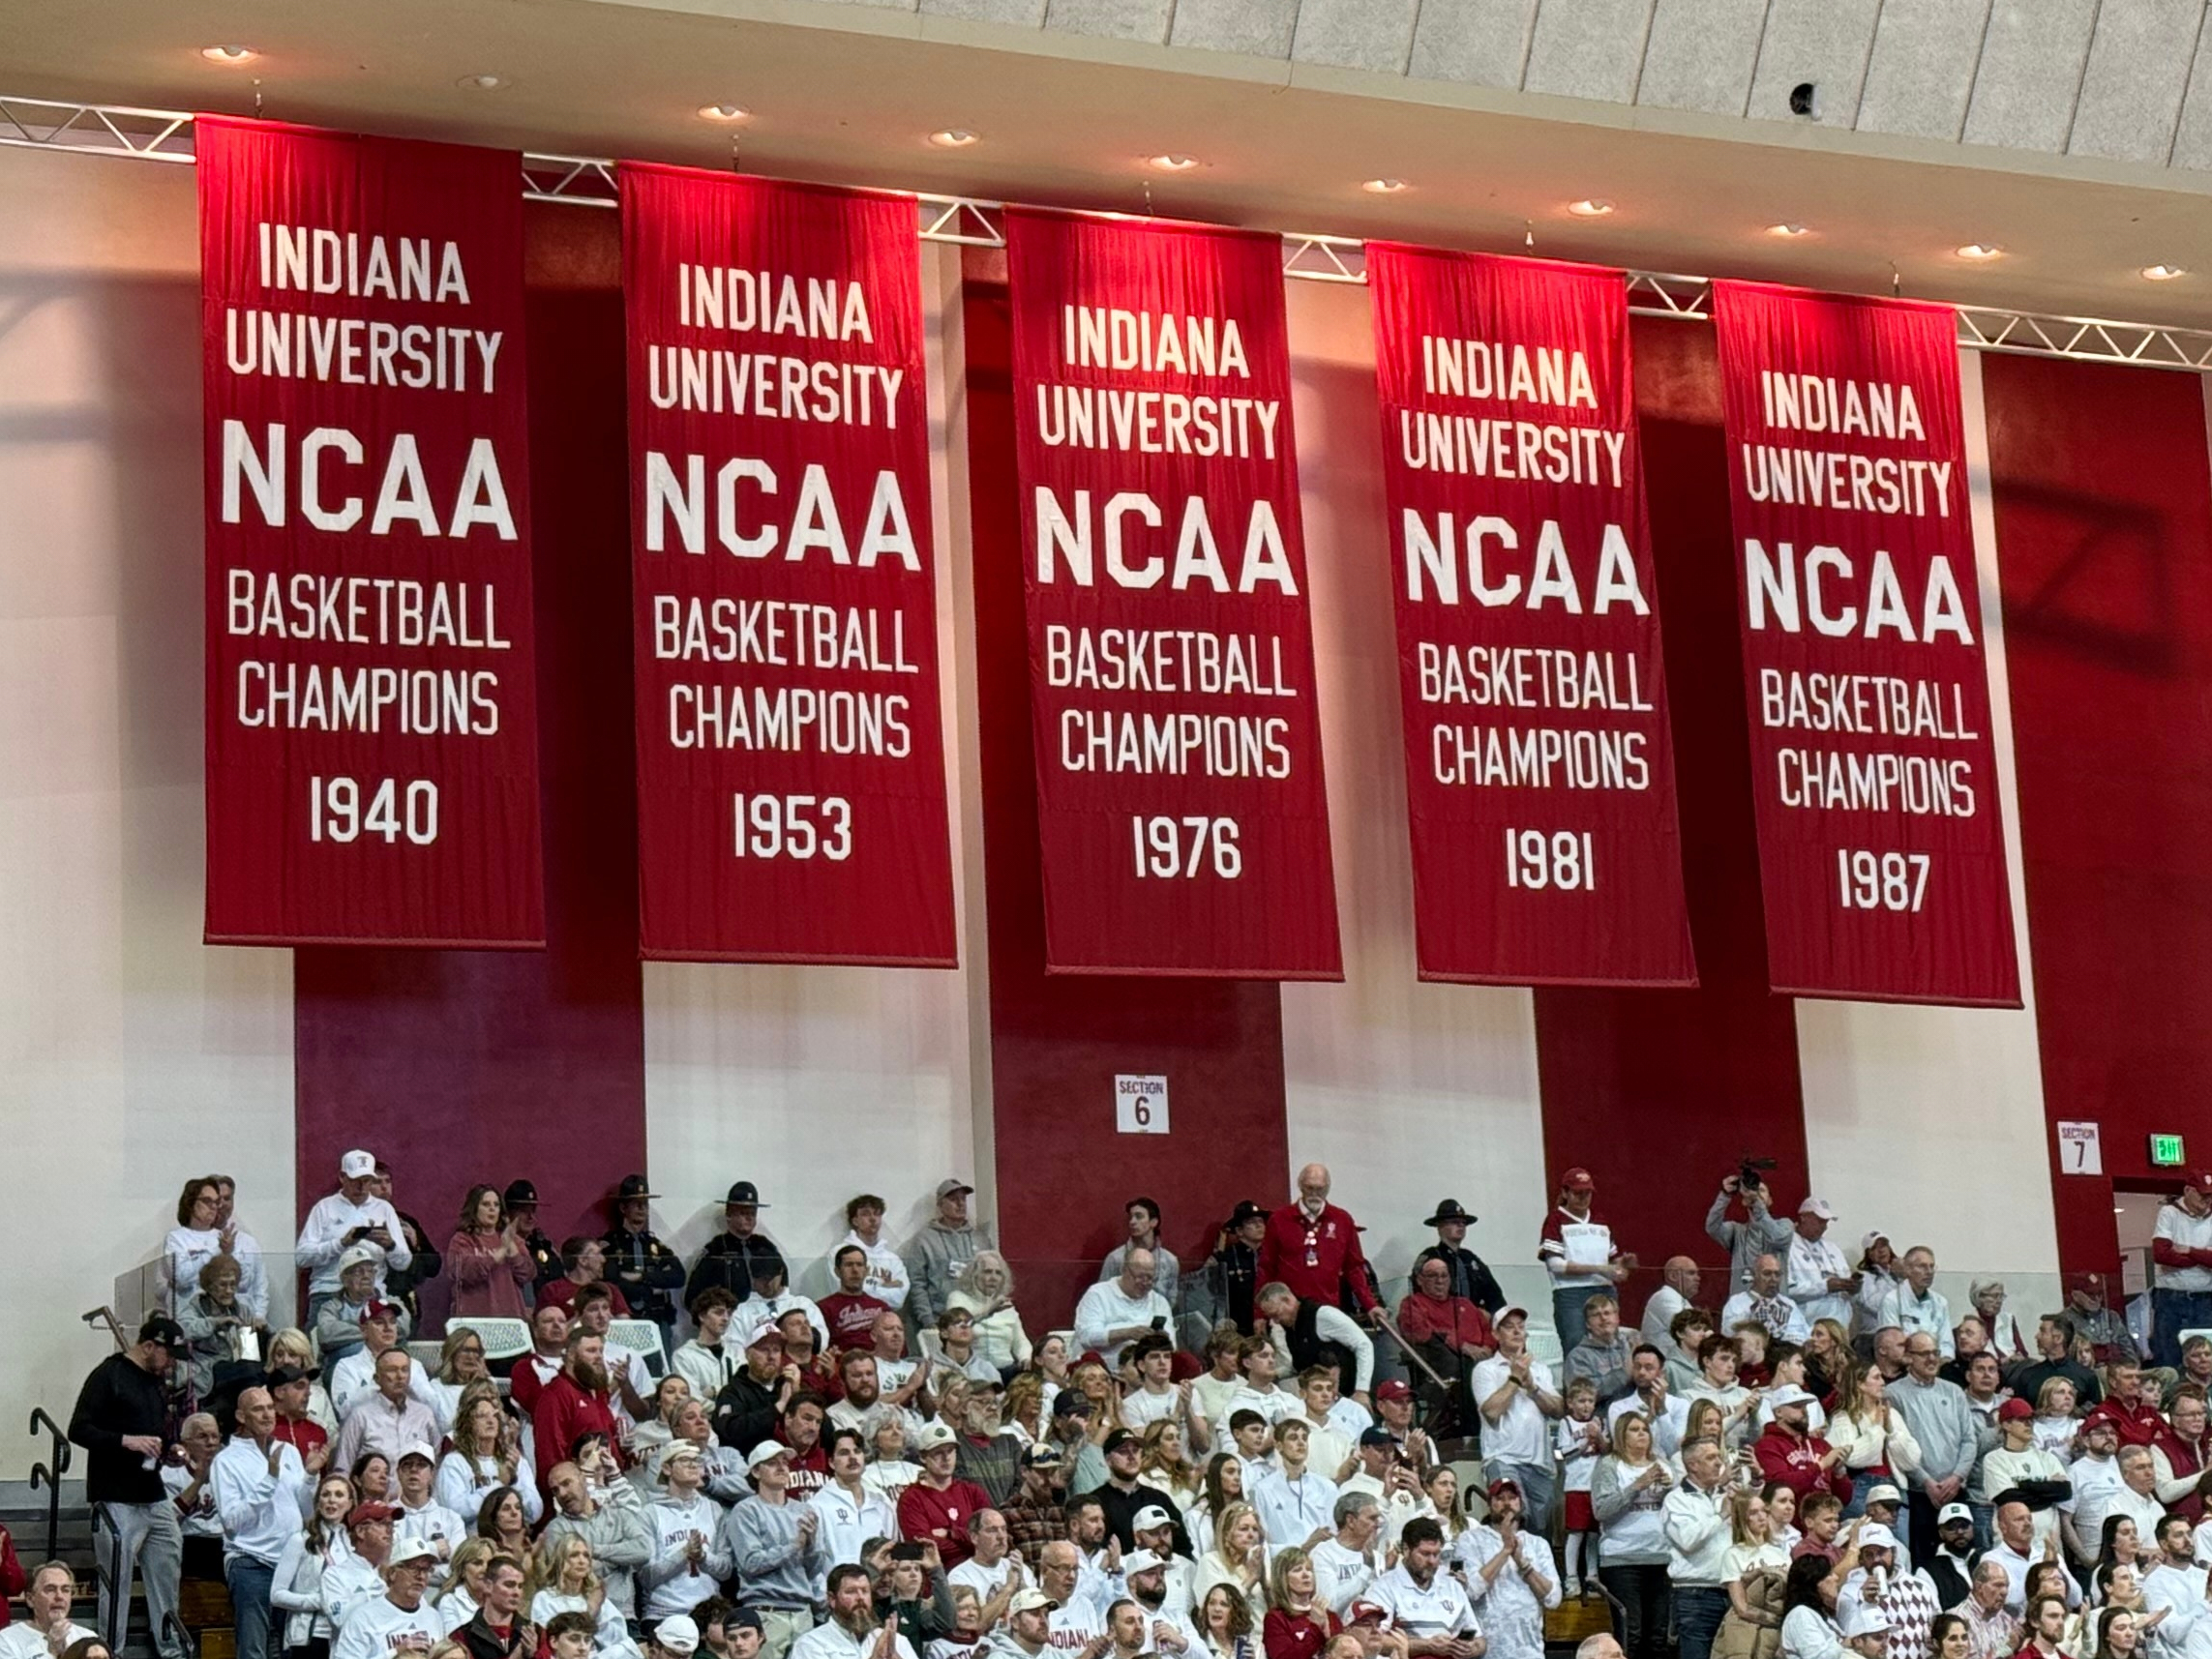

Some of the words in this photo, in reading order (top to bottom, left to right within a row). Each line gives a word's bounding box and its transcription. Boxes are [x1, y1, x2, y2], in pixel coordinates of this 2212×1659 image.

[259, 222, 469, 304] INDIANA
[680, 263, 873, 342] INDIANA
[227, 309, 502, 393] UNIVERSITY
[1065, 305, 1250, 377] INDIANA
[1423, 336, 1598, 408] INDIANA
[650, 345, 903, 429] UNIVERSITY
[1037, 384, 1279, 459] UNIVERSITY
[1762, 370, 1926, 440] INDIANA
[223, 420, 518, 540] NCAA
[1402, 410, 1625, 487] UNIVERSITY
[1744, 444, 1951, 517] UNIVERSITY
[646, 452, 921, 571] NCAA
[1036, 487, 1299, 596] NCAA
[1404, 509, 1650, 615] NCAA
[1746, 538, 1975, 645] NCAA
[229, 570, 510, 648] BASKETBALL
[655, 596, 918, 673] BASKETBALL
[1047, 625, 1297, 696] BASKETBALL
[1419, 642, 1653, 711] BASKETBALL
[239, 661, 497, 734] CHAMPIONS
[671, 685, 911, 757] CHAMPIONS
[1761, 669, 1978, 739] BASKETBALL
[1061, 710, 1290, 778] CHAMPIONS
[1434, 725, 1649, 789] CHAMPIONS
[312, 777, 437, 844] 1940
[1779, 749, 1975, 816] CHAMPIONS
[735, 793, 851, 860] 1953
[1133, 816, 1241, 878] 1976
[1507, 829, 1594, 890] 1981
[1838, 849, 1929, 911] 1987
[1120, 1081, 1164, 1094] SECTION
[1135, 1096, 1151, 1126] 6
[2061, 1127, 2096, 1140] SECTION
[2074, 1141, 2085, 1168] 7
